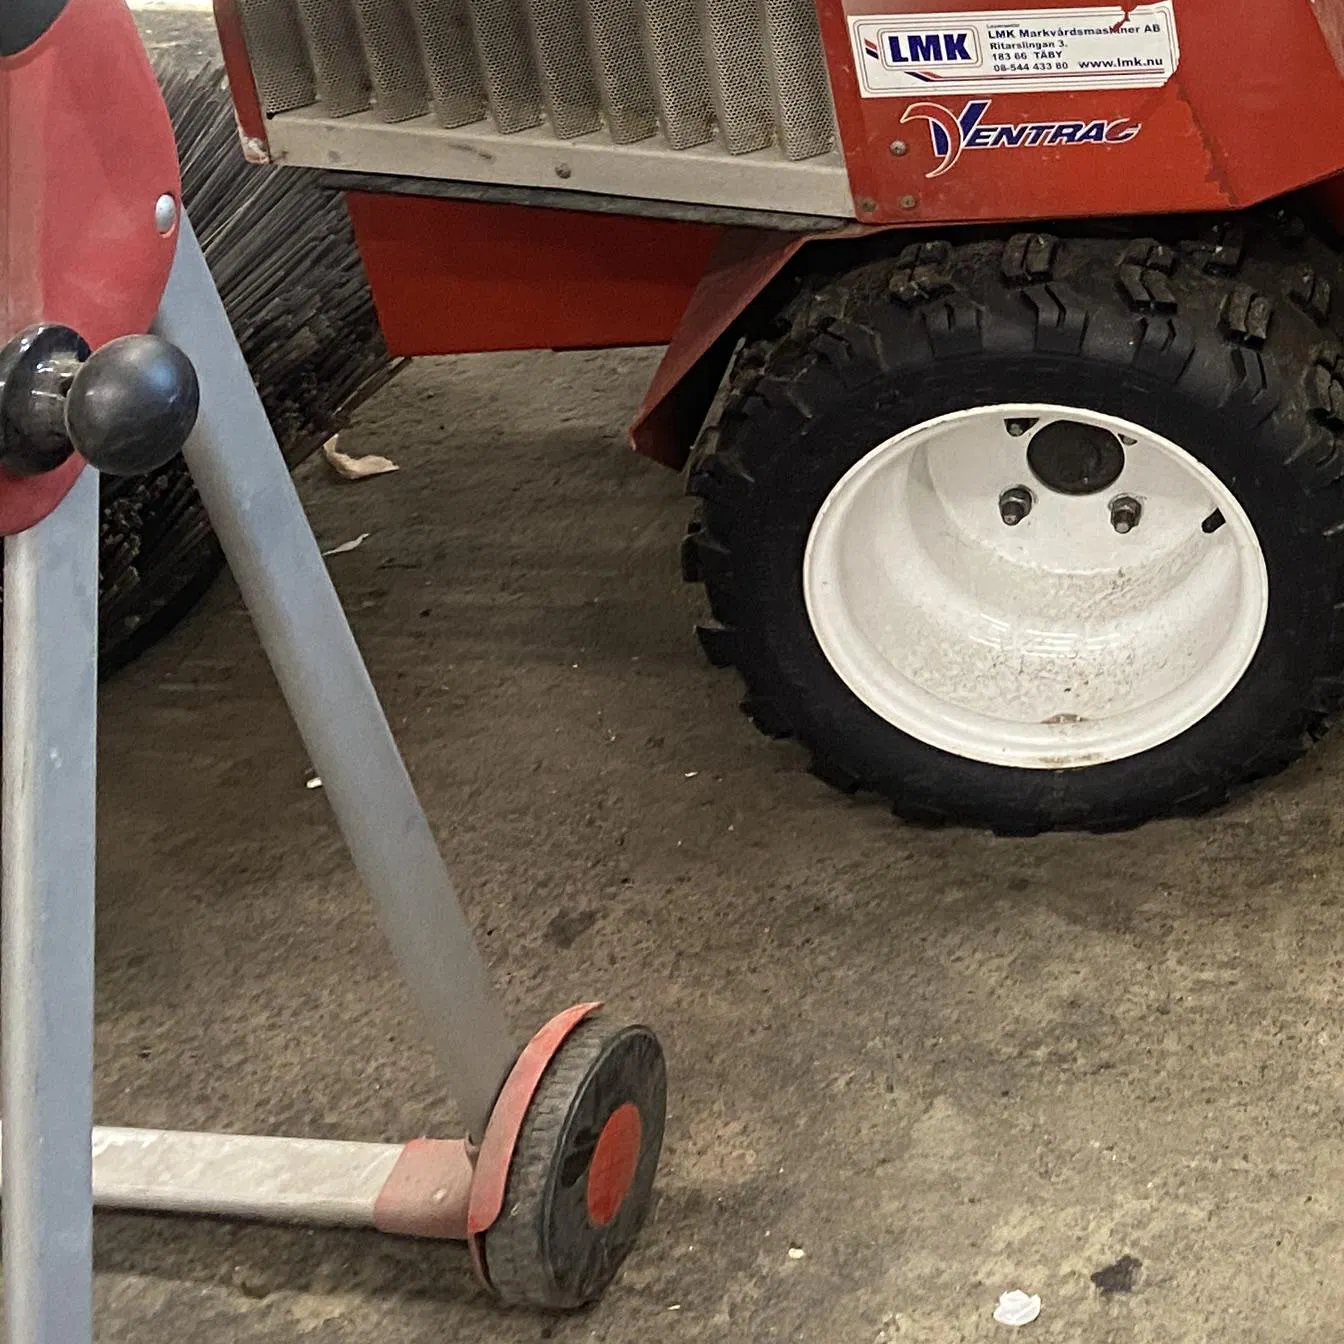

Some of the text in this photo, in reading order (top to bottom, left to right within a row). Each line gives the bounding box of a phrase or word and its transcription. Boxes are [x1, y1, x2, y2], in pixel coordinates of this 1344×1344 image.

[988, 29, 1015, 39] LMK
[1144, 23, 1161, 33] AB
[888, 33, 972, 63] LMK
[992, 52, 1011, 62] 183
[1078, 57, 1163, 69] www.lmk.nu
[993, 61, 1069, 72] 08-544 433 80
[900, 99, 1142, 179] VENTRAC
